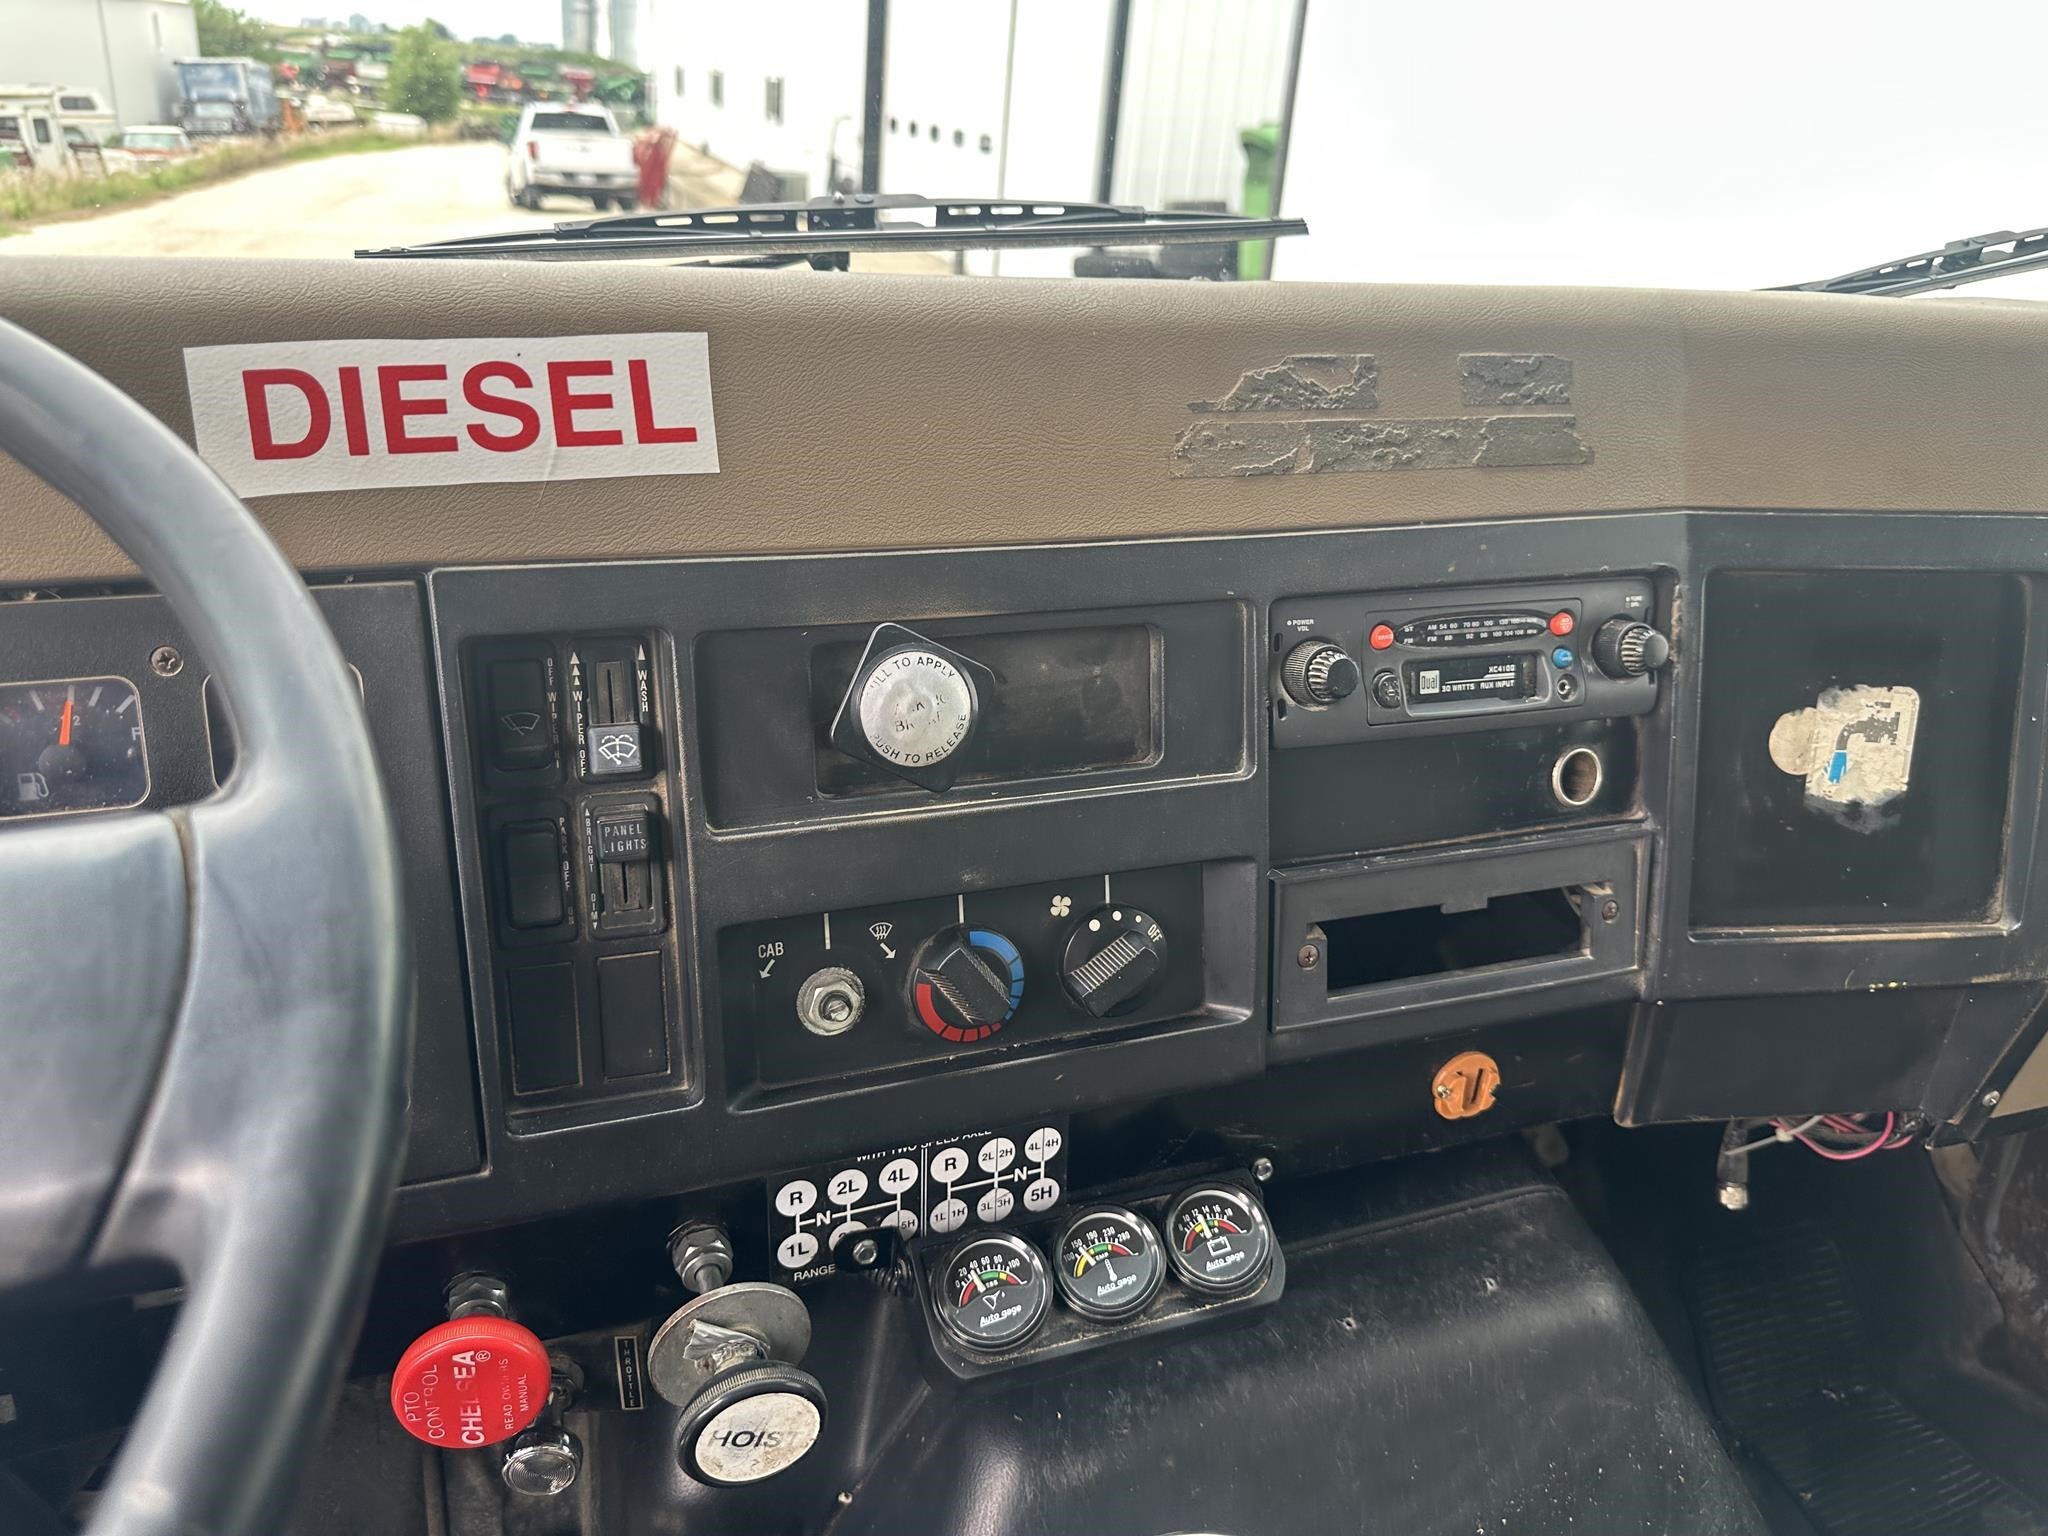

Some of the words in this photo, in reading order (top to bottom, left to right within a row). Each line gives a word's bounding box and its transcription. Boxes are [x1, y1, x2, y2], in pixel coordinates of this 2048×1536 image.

[242, 359, 698, 461] DIESEL
[893, 656, 911, 669] TO
[917, 656, 956, 680] APPLY
[1421, 674, 1439, 691] Dual
[1452, 683, 1475, 692] WATTS
[1480, 681, 1495, 690] AUX
[1495, 680, 1516, 688] INPUT
[637, 669, 649, 713] WASH
[572, 690, 585, 745] WIPER
[579, 750, 588, 777] OFF
[904, 753, 921, 764] TO
[926, 713, 968, 762] RELEASE
[604, 823, 643, 837] PANEL
[585, 818, 595, 873] BRIGHT
[1146, 923, 1163, 945] OFF
[758, 941, 784, 959] CAB
[1028, 1141, 1041, 1151] 4L
[1045, 1138, 1059, 1148] 4H
[982, 1152, 995, 1162] 2L
[999, 1148, 1013, 1158] 2H
[944, 1157, 957, 1172] R
[887, 1170, 910, 1183] 4L
[1014, 1166, 1028, 1182] N
[837, 1179, 860, 1196] 2L
[1031, 1185, 1053, 1202] 5H
[789, 1191, 804, 1206] R
[997, 1197, 1011, 1208] 3H
[952, 1207, 966, 1218] 1H
[981, 1201, 993, 1212] 3L
[1191, 1208, 1200, 1217] 12
[1201, 1204, 1210, 1213] 14
[1212, 1204, 1221, 1213] 16
[816, 1210, 831, 1227] N
[901, 1219, 915, 1230] 5H
[934, 1213, 946, 1222] 1L
[1086, 1230, 1098, 1241] 190
[1102, 1226, 1116, 1237] 230
[787, 1242, 810, 1257] 1L
[1071, 1238, 1083, 1249] 150
[980, 1255, 990, 1265] 60
[993, 1254, 1003, 1264] 80
[1008, 1258, 1021, 1269] 100
[1063, 1251, 1075, 1262] 100
[1206, 1258, 1225, 1271] Auto
[1225, 1251, 1245, 1263] gage
[793, 1263, 837, 1281] RANGE
[958, 1266, 968, 1277] 20
[969, 1260, 979, 1269] 40
[1097, 1283, 1116, 1295] Auto
[1116, 1274, 1137, 1287] gage
[980, 1312, 1000, 1325] Auto
[1001, 1304, 1022, 1318] gage
[623, 1340, 635, 1407] THROTTLE
[518, 1374, 529, 1412] MANUAL
[403, 1391, 422, 1422] PTO
[421, 1364, 446, 1439] CONTROL
[503, 1404, 514, 1430] READ
